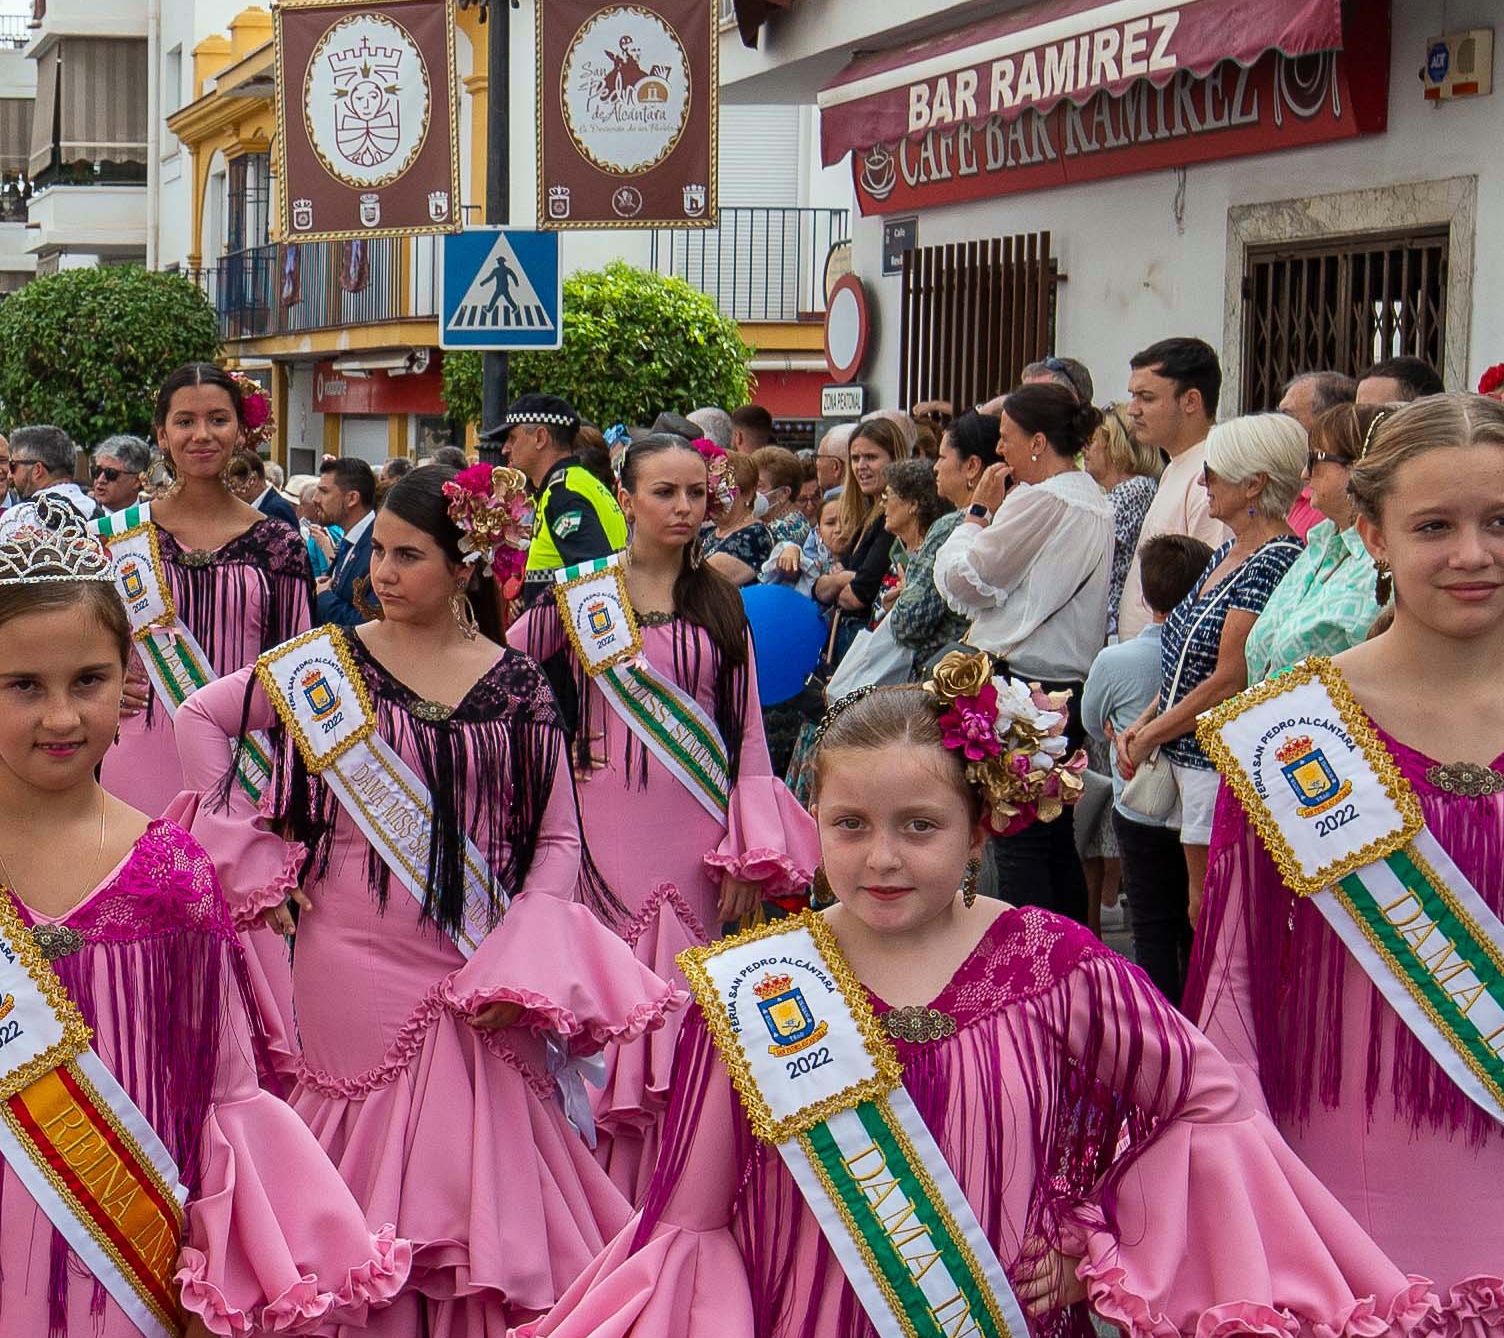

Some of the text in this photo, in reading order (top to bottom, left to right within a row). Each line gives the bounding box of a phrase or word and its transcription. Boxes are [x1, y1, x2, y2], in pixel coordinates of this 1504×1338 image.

[580, 61, 607, 78] San
[907, 11, 1182, 132] BAR RAMIREZ
[985, 113, 1059, 172] BAR
[1063, 67, 1262, 157] RAMIREZ
[823, 392, 837, 411] ZONA
[596, 633, 617, 650] 2022
[623, 675, 671, 724] MISS
[321, 711, 345, 734] 2022
[1260, 718, 1296, 745] PEDRO
[1298, 716, 1357, 753] ALCÁNTARA
[1252, 745, 1265, 767] SAN
[350, 763, 391, 808] DAMA
[382, 799, 419, 839] MISS
[1254, 769, 1270, 801] FERIA
[1315, 803, 1360, 838] 2022
[1377, 886, 1488, 1020] DAMA
[727, 956, 836, 1034] FERIA SAN PEDRO ALCÁNTARA
[786, 1047, 834, 1080] 2022
[39, 1099, 142, 1227] REINA
[839, 1137, 943, 1287] DAMA
